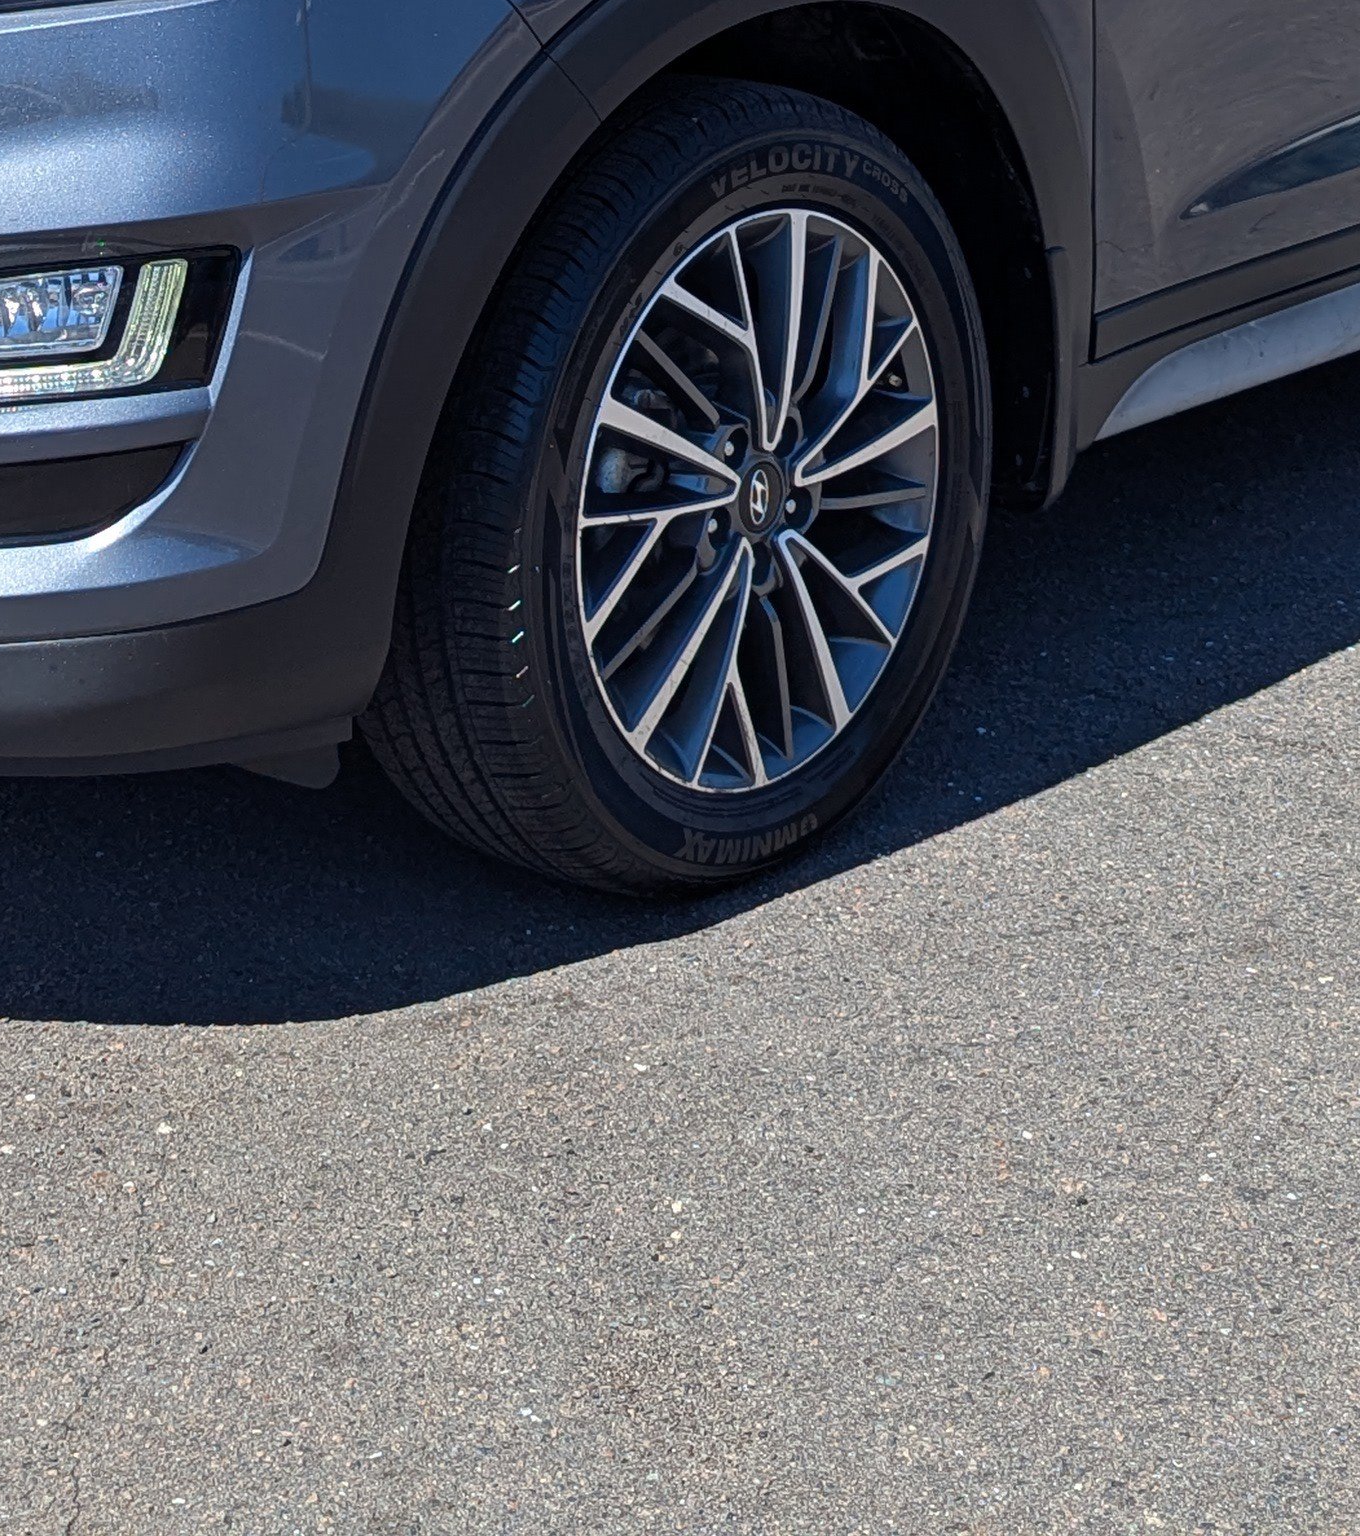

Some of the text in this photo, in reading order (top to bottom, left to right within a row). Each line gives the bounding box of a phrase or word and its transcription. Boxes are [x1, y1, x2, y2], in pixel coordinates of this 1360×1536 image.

[711, 143, 860, 198] VELOCITY
[862, 159, 908, 202] CROSS
[675, 813, 818, 864] OMNIMAX
